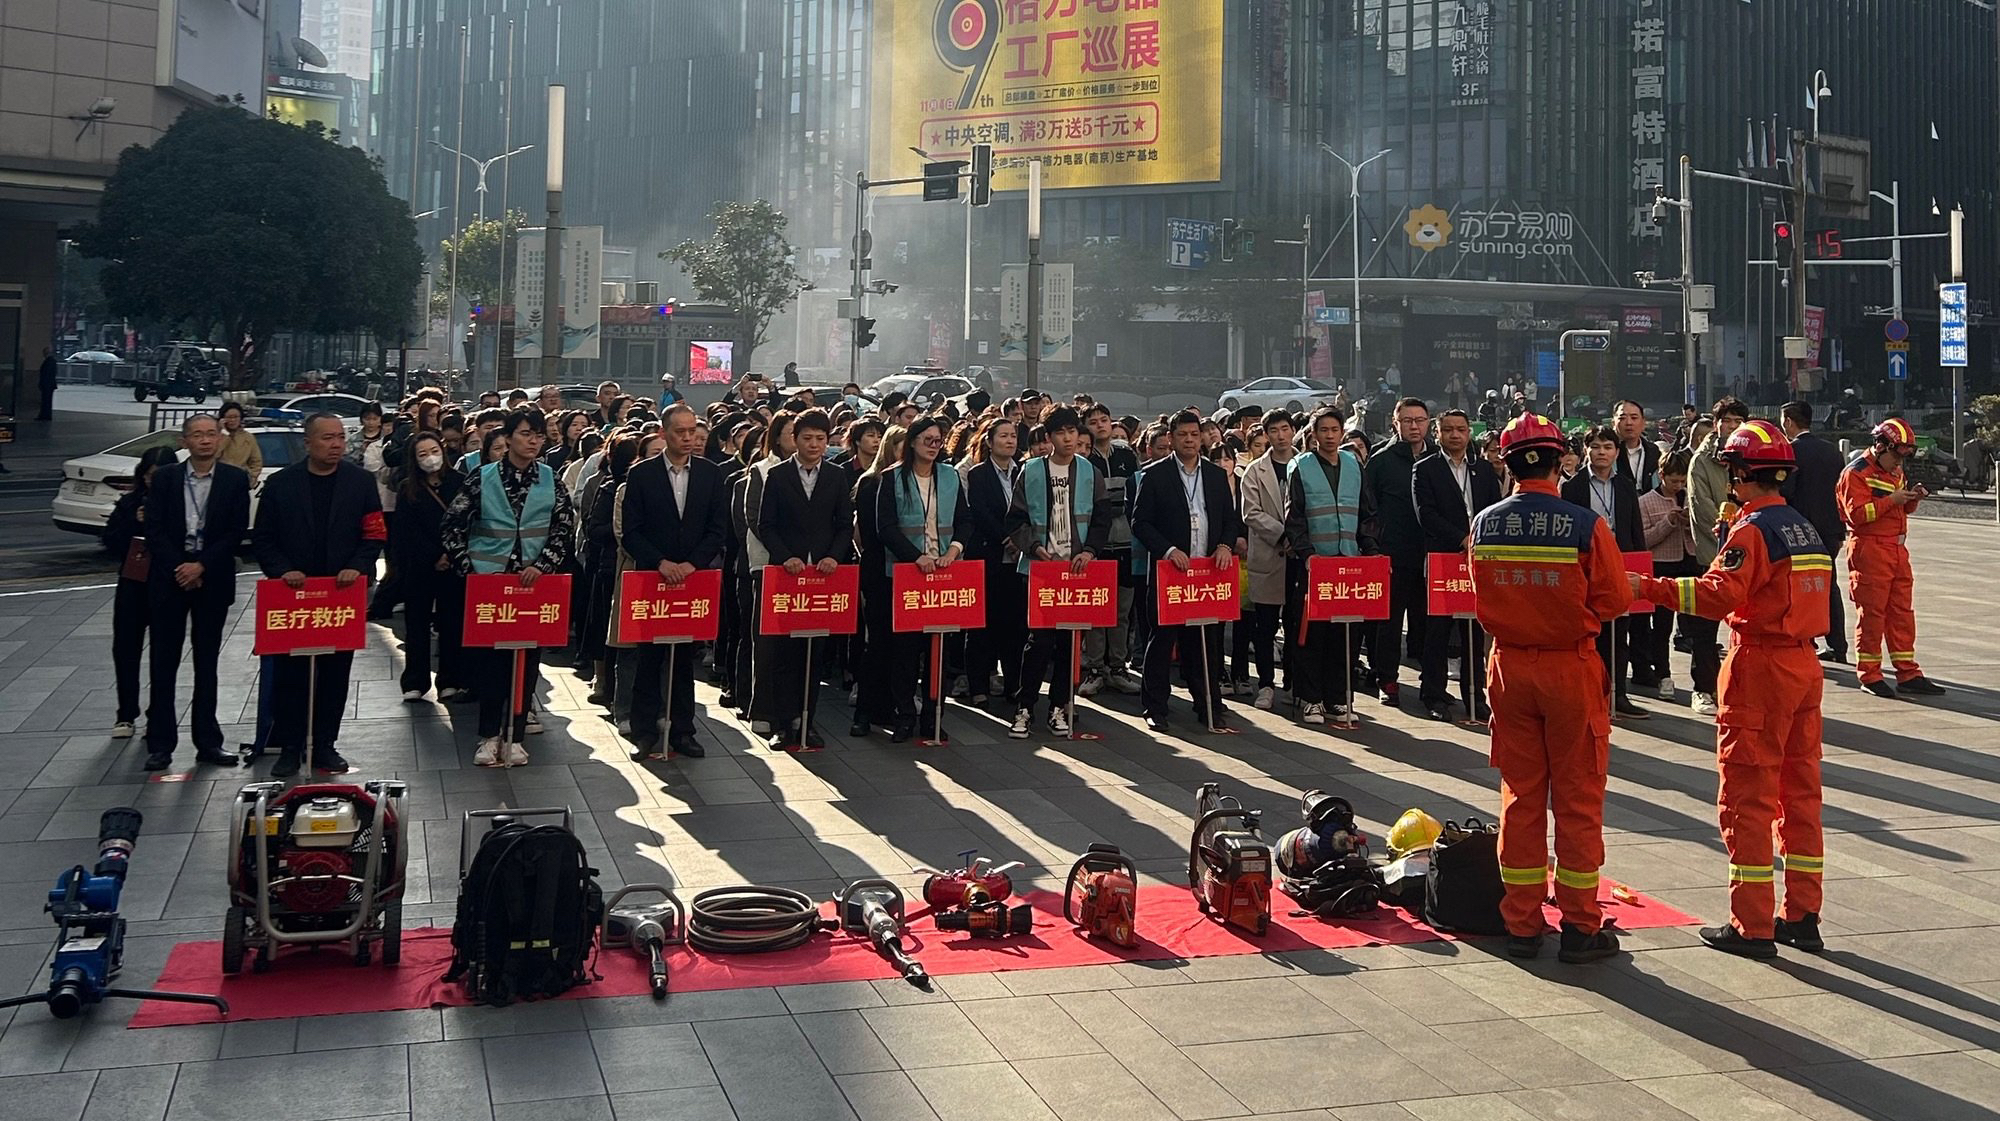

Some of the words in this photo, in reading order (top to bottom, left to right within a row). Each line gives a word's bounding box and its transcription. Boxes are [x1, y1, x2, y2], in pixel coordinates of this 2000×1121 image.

[1004, 20, 1160, 79] 工厂巡展
[1452, 4, 1467, 76] 九鼎轩
[1475, 2, 1489, 75] 脆毛肚火锅
[1461, 83, 1479, 96] 3F
[1631, 0, 1666, 238] 诺富特酒店
[1459, 210, 1573, 239] 苏宁易购
[1459, 240, 1573, 259] suning.com
[1816, 230, 1841, 257] 15
[1482, 511, 1574, 538] 应急消防
[1493, 568, 1561, 586] 江苏南京
[772, 593, 849, 613] 营业三部
[902, 588, 977, 611] 营业四部
[1038, 587, 1109, 607] 营业五部
[1166, 582, 1232, 605] 营业六部
[1317, 582, 1384, 601] 营业七部
[266, 606, 356, 630] 医疗救护
[475, 603, 561, 624] 营业一部
[630, 598, 710, 620] 营业二部
